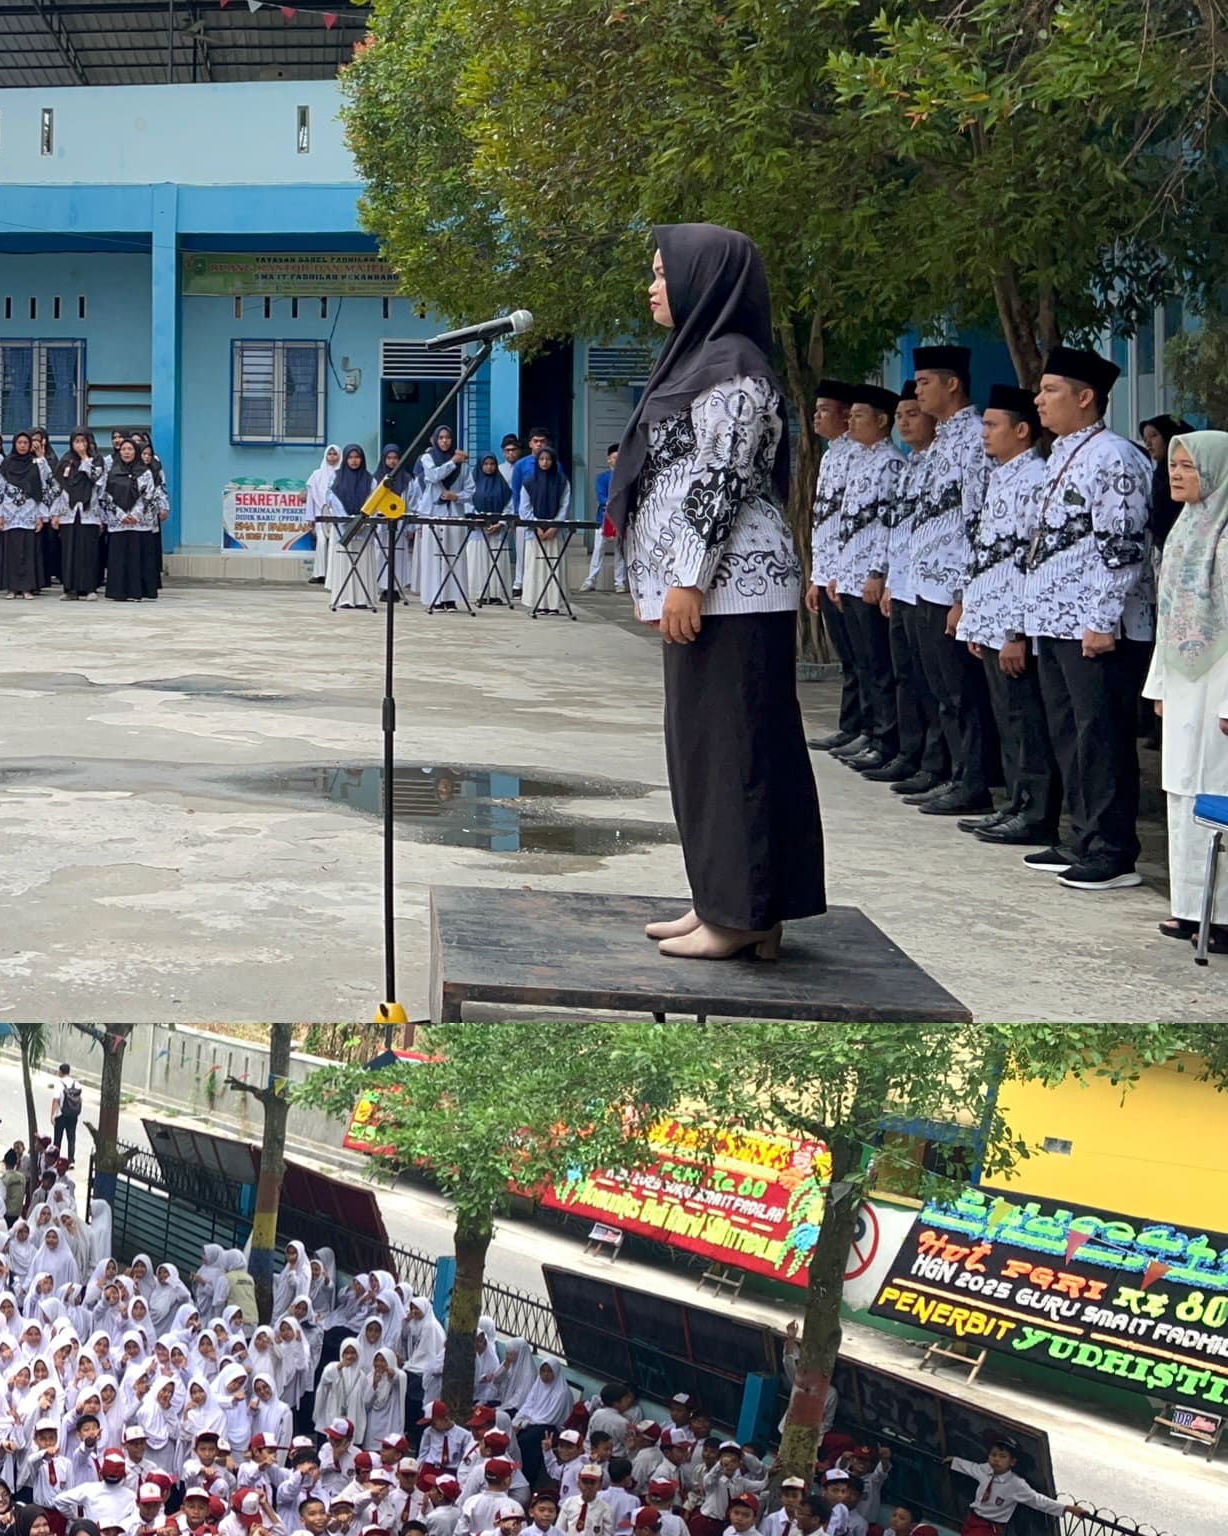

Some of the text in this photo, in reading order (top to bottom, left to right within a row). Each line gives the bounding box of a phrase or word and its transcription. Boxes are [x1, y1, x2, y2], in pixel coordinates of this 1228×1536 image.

[910, 1253, 958, 1284] HGN
[954, 1271, 1014, 1299] 2025
[1015, 1287, 1081, 1322] GURU
[1000, 1258, 1109, 1301] PGRI
[1174, 1290, 1228, 1328] 80
[877, 1286, 1228, 1406] PENERBIT YUDHISTI
